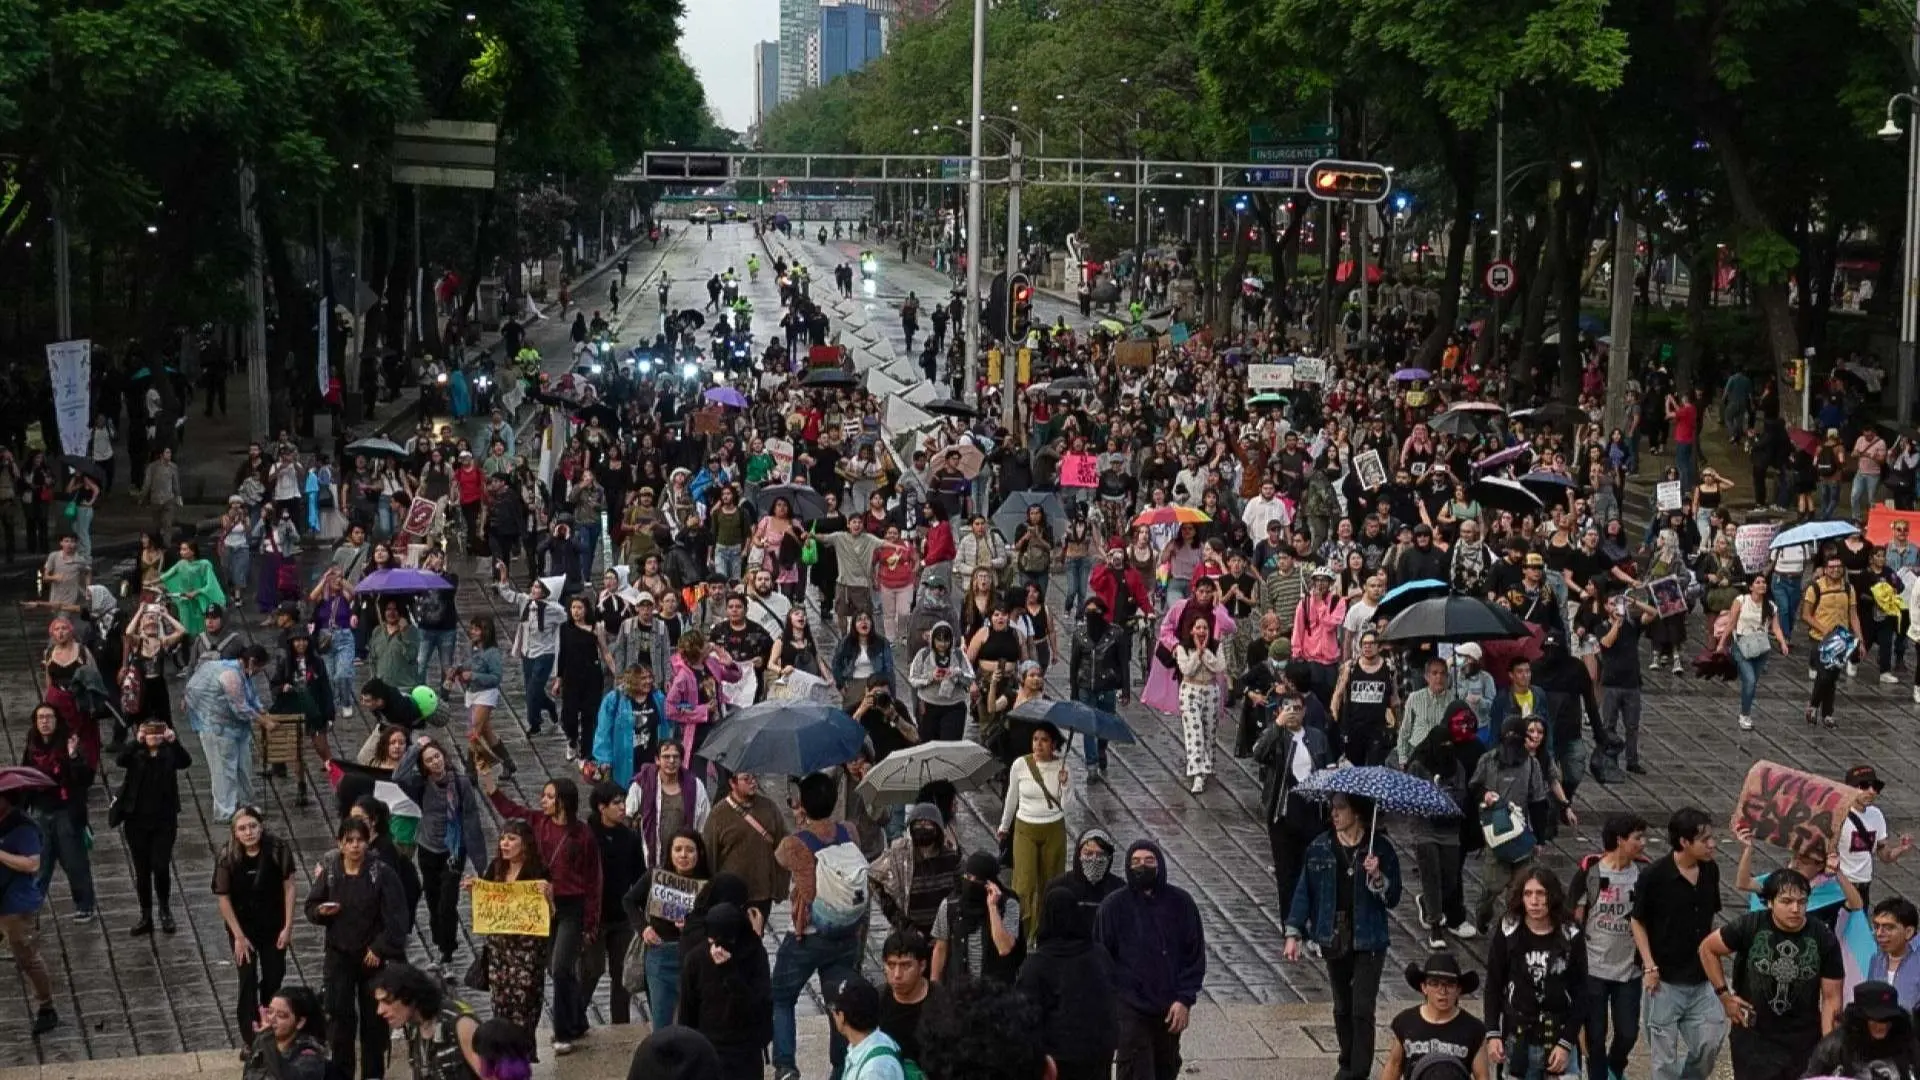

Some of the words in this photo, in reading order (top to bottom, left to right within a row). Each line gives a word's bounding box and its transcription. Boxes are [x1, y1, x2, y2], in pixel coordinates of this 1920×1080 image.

[1256, 147, 1321, 159] INSURGENTES
[655, 871, 699, 895] CLAUDIA
[1600, 903, 1624, 915] DAD
